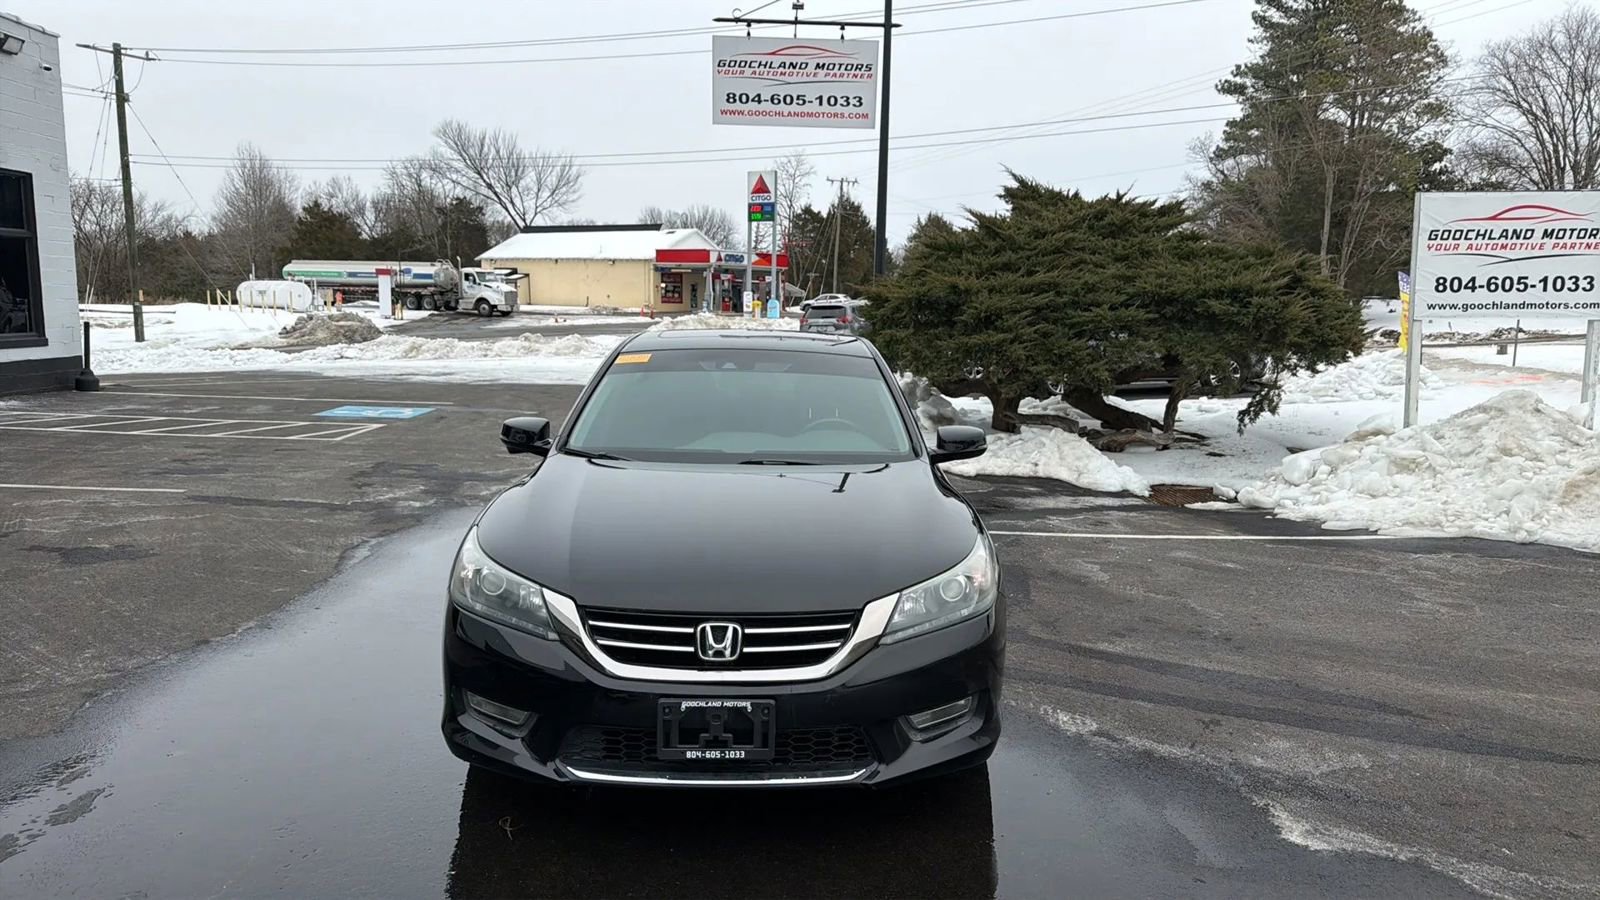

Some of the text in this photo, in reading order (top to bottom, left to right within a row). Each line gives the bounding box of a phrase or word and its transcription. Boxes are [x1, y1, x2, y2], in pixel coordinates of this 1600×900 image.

[717, 59, 874, 72] GOOCHLAND MOTORS
[750, 70, 819, 78] AUTOMOTIVE
[725, 92, 864, 108] 804-605-1033
[719, 108, 869, 120] WWW.GOOCHLANDMOTORS.COM
[1427, 228, 1600, 241] GOOCHLAND MOTOR
[1426, 242, 1460, 251] YOUR
[1465, 242, 1547, 251] AUTOMOTIVE
[724, 254, 745, 263] CITGO
[1434, 275, 1595, 293] 804-605-1033
[1427, 301, 1600, 312] www.goochlandmotors.com
